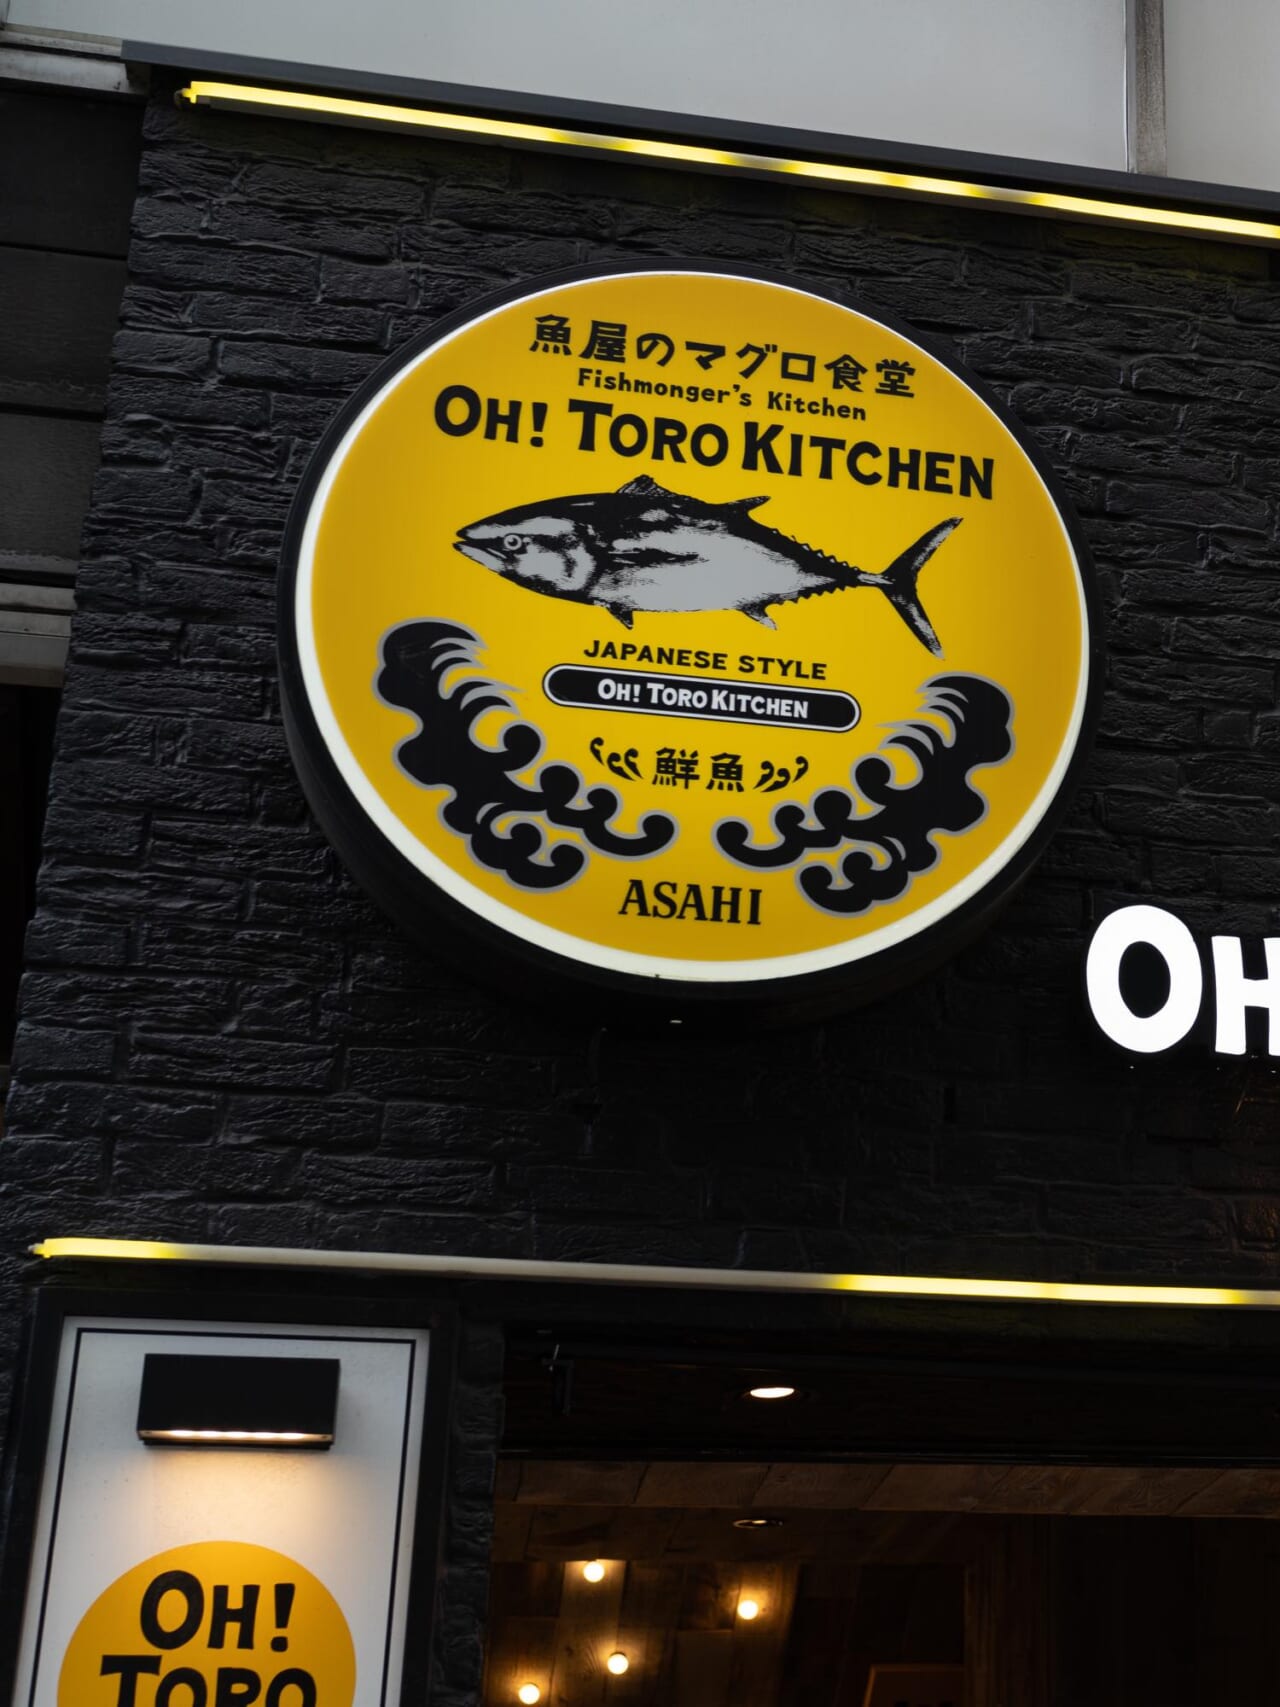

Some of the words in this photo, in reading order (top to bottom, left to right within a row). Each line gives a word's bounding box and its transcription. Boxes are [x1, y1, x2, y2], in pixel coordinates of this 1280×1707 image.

[529, 314, 916, 398] 魚屋のマグロ食堂
[578, 367, 752, 407] Fishmonger's
[767, 391, 866, 421] Kitchen
[434, 385, 547, 447] OH!
[568, 398, 729, 466] TORO
[742, 421, 994, 500] KITCHEN
[584, 640, 728, 670] JAPANESE
[738, 655, 827, 680] STYLE
[597, 678, 641, 703] OH!
[647, 682, 708, 709] TORO
[711, 689, 808, 719] KITCHEN
[652, 747, 745, 793] 鮮魚
[618, 879, 762, 925] ASAHI
[139, 1569, 296, 1653] OH!
[100, 1654, 317, 1707] TORO
